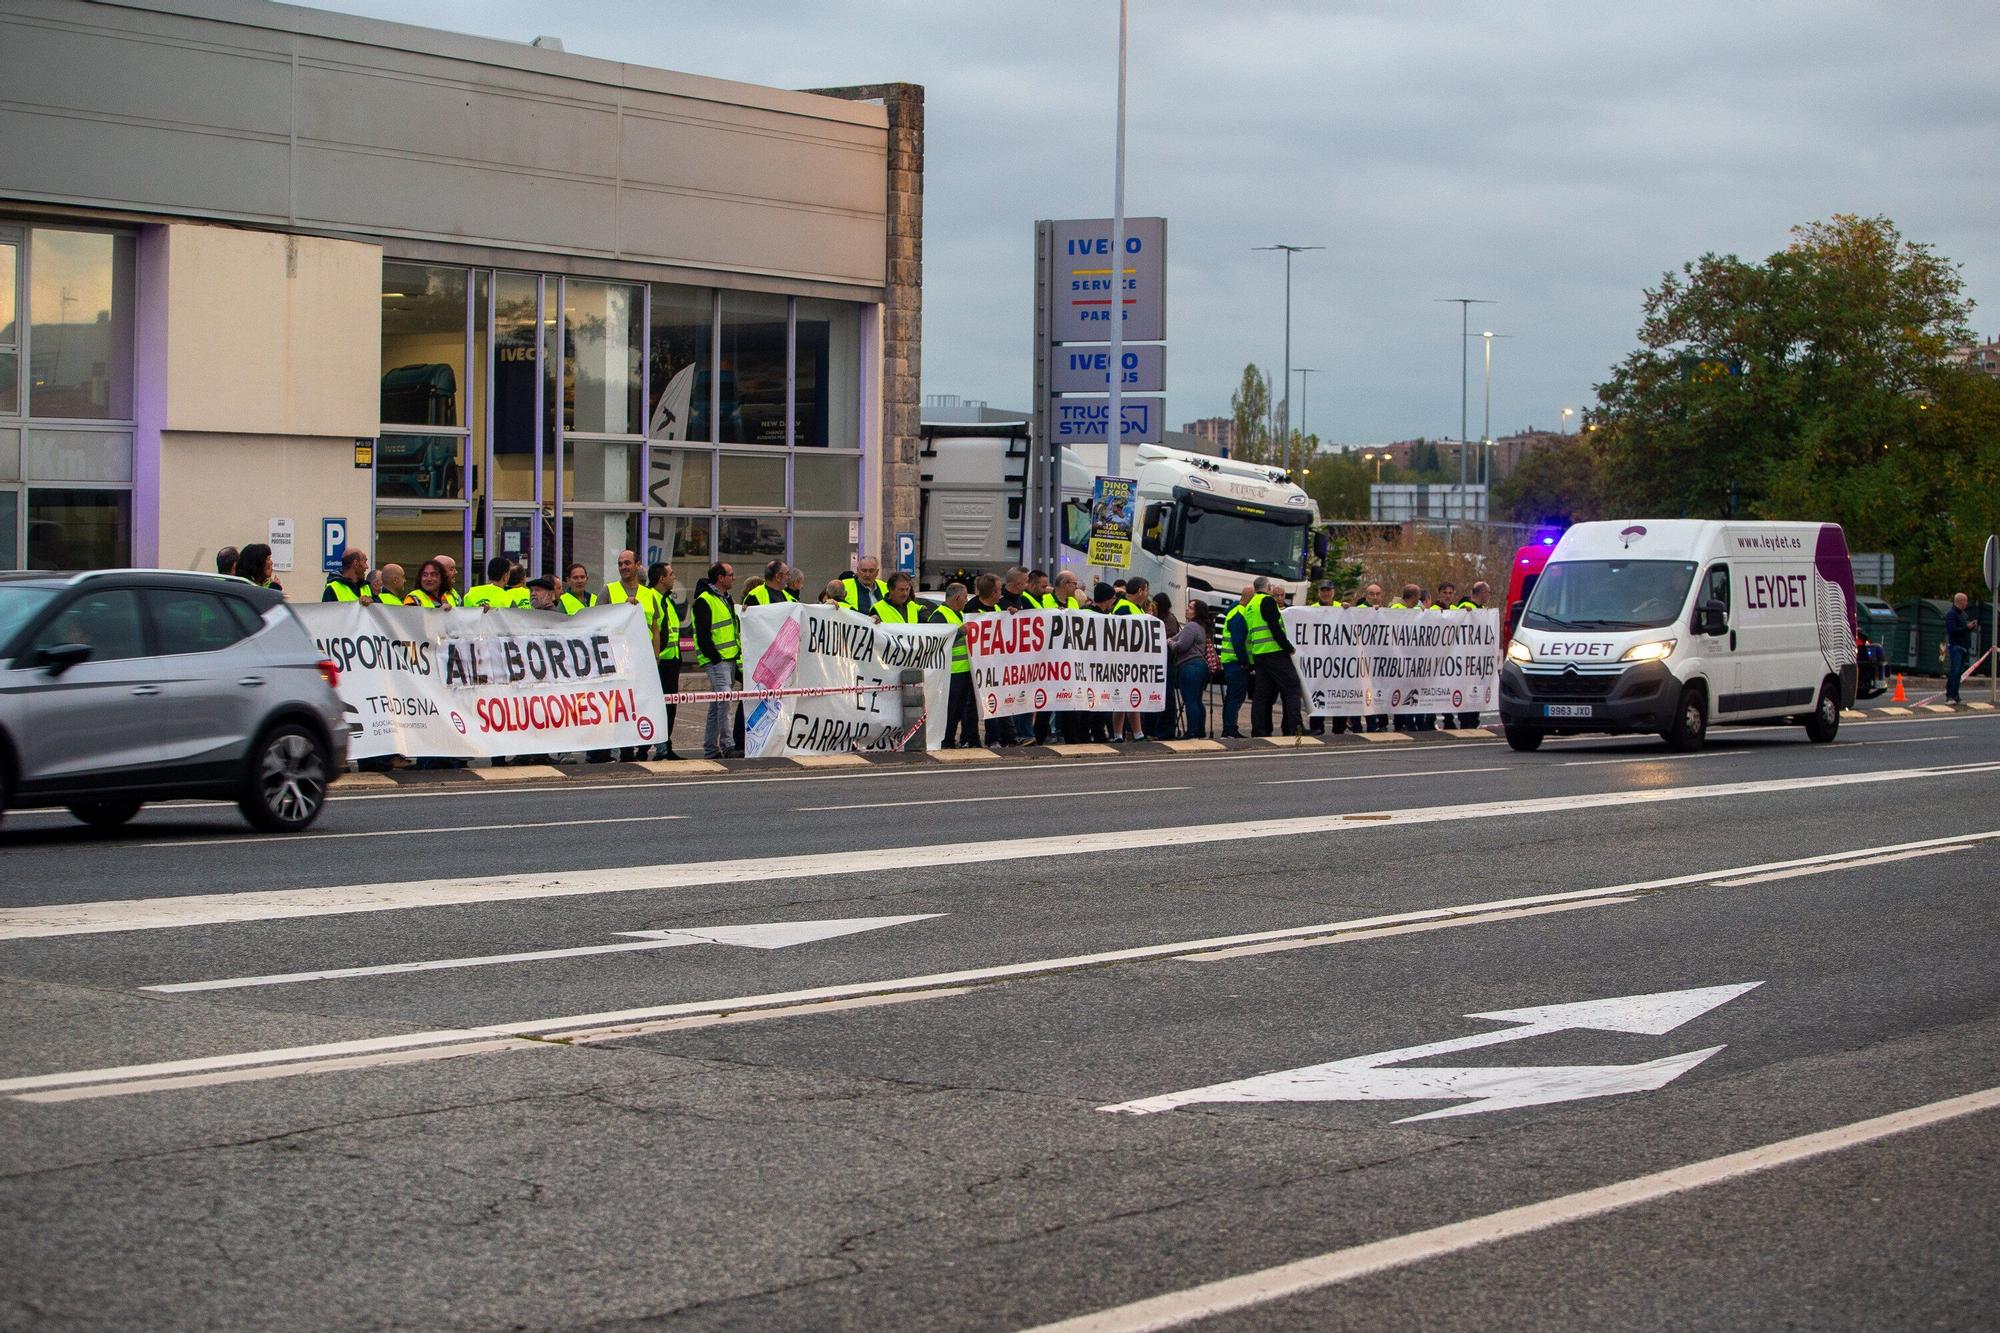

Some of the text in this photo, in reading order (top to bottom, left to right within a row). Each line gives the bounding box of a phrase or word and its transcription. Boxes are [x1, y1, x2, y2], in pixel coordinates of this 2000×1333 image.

[1068, 237, 1142, 256] IVEO
[1080, 310, 1128, 320] PARS
[1070, 352, 1138, 370] IVEO
[1102, 488, 1128, 497] EXPO
[1103, 481, 1129, 490] DINO
[326, 523, 345, 556] P
[1096, 541, 1123, 550] COMPRA
[1737, 535, 1802, 551] www.leydet.es
[900, 536, 914, 565] P
[1744, 575, 1807, 609] LEYDET
[967, 615, 1162, 657] PEAJES PARA NADIE
[1296, 623, 1308, 645] EL
[1313, 624, 1389, 646] TRANSPORTE
[1391, 624, 1441, 647] NAVARRO
[1441, 624, 1481, 646] CONTRA
[446, 643, 488, 685] AL
[504, 635, 616, 682] BORDE
[1539, 643, 1614, 656] LEYDET
[985, 667, 999, 687] AL
[1002, 661, 1072, 686] ABANDONO
[1090, 662, 1165, 684] TRANSPORTE
[1372, 656, 1431, 678] TRIBUTARIA
[1432, 657, 1440, 677] Y
[1440, 656, 1462, 677] LOS
[1465, 656, 1495, 680] PEAJES
[477, 691, 600, 733] SOLUCIONES
[1551, 706, 1590, 716] 9963 JXD
